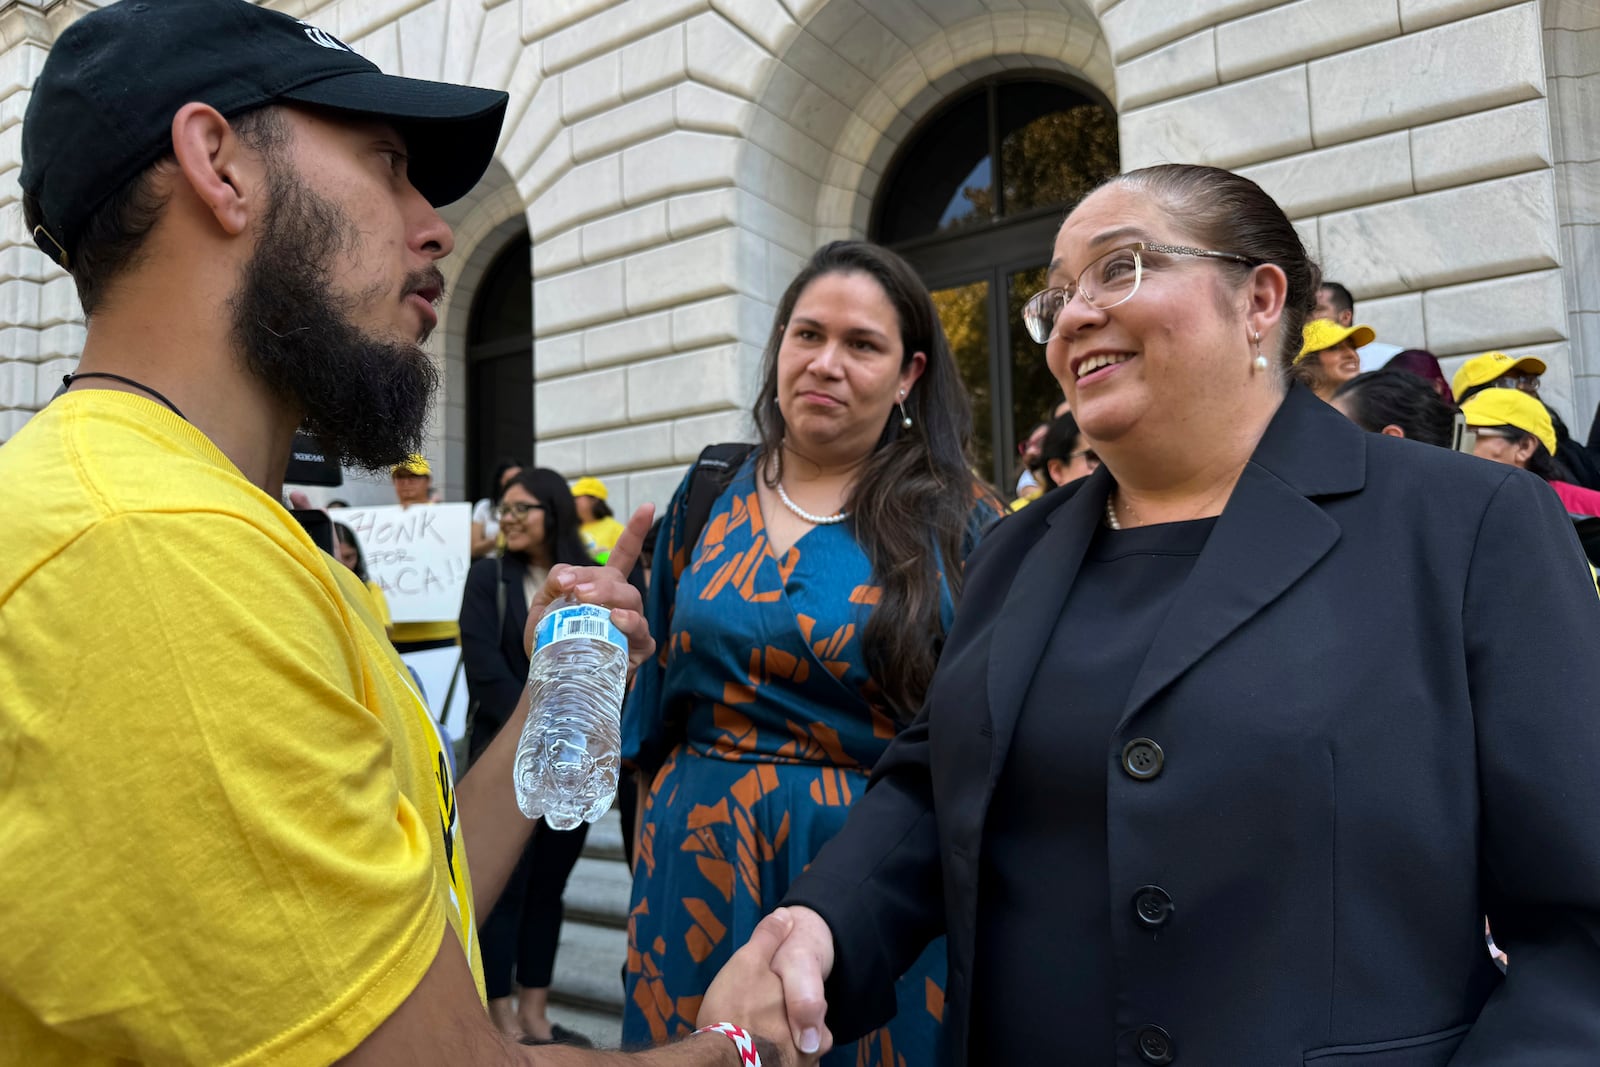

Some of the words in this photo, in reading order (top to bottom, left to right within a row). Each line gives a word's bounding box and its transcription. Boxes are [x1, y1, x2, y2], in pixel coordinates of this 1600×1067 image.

[348, 510, 446, 545] HONK
[367, 549, 417, 568] FOR
[375, 556, 466, 597] ACA!!
